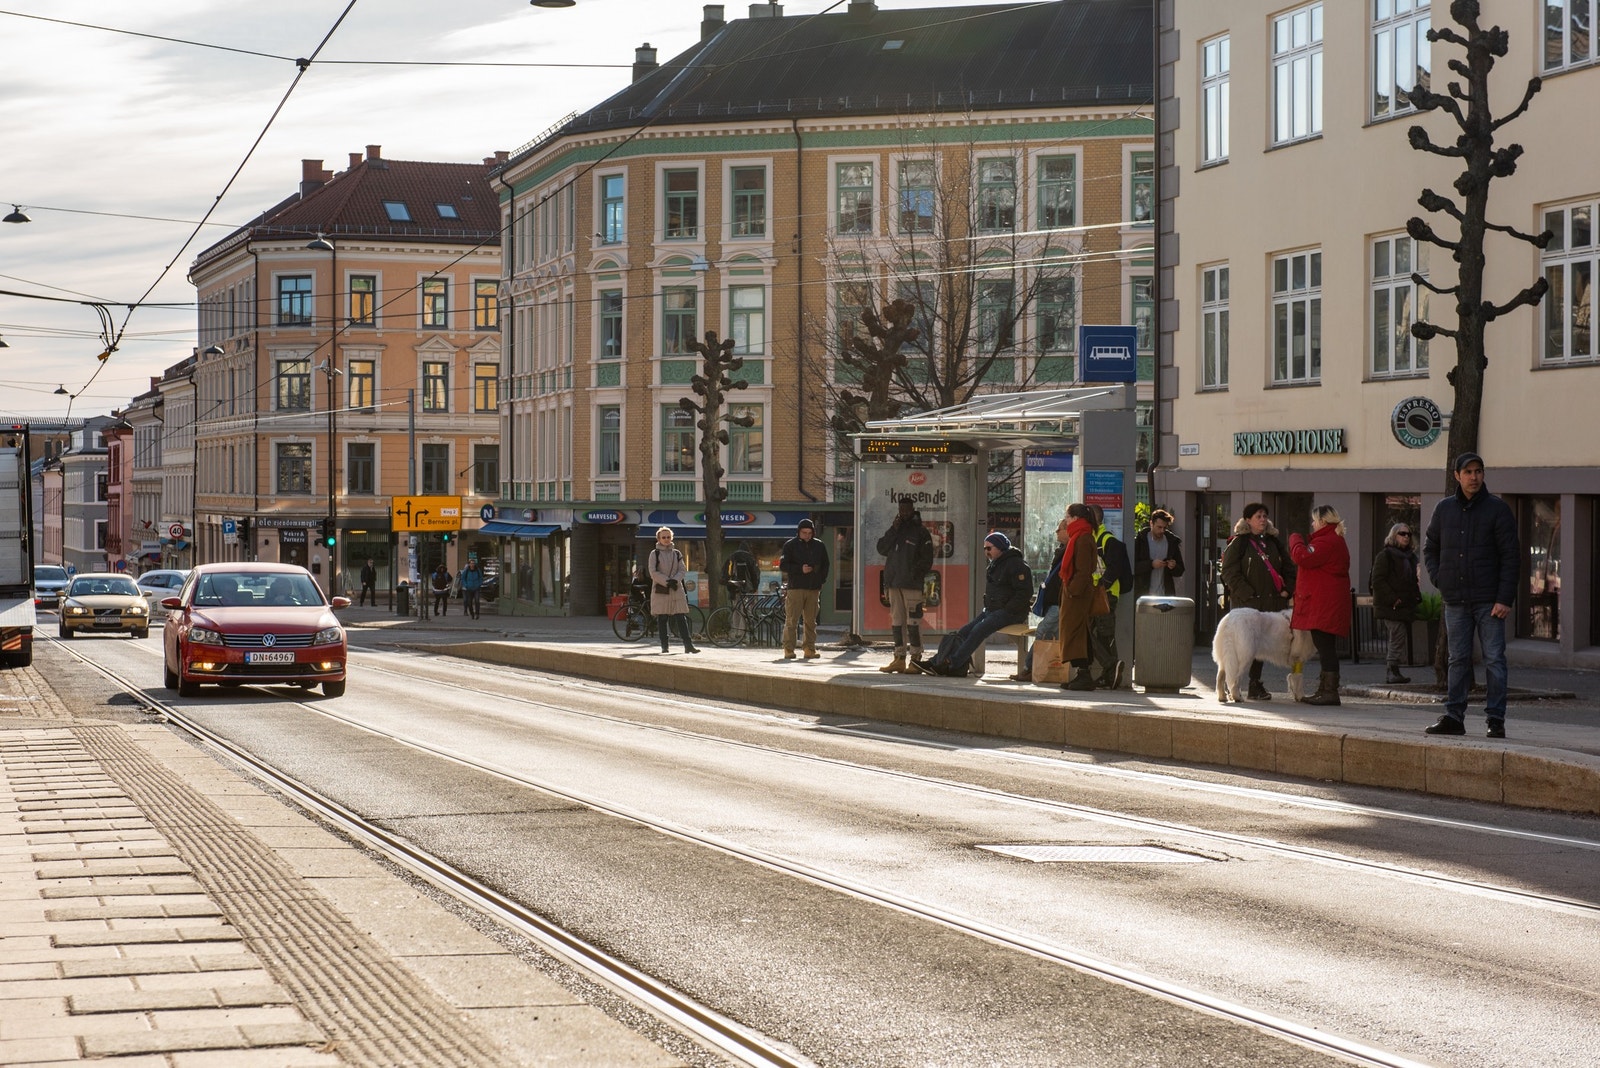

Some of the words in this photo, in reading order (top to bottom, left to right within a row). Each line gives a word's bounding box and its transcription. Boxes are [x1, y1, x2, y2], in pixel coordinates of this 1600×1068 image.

[1400, 400, 1438, 420] ESPRESSO
[1233, 430, 1294, 455] ESPRESSO
[1295, 428, 1344, 454] HOUSE
[1404, 433, 1434, 446] HOUSE
[483, 509, 492, 518] N
[226, 523, 232, 532] P
